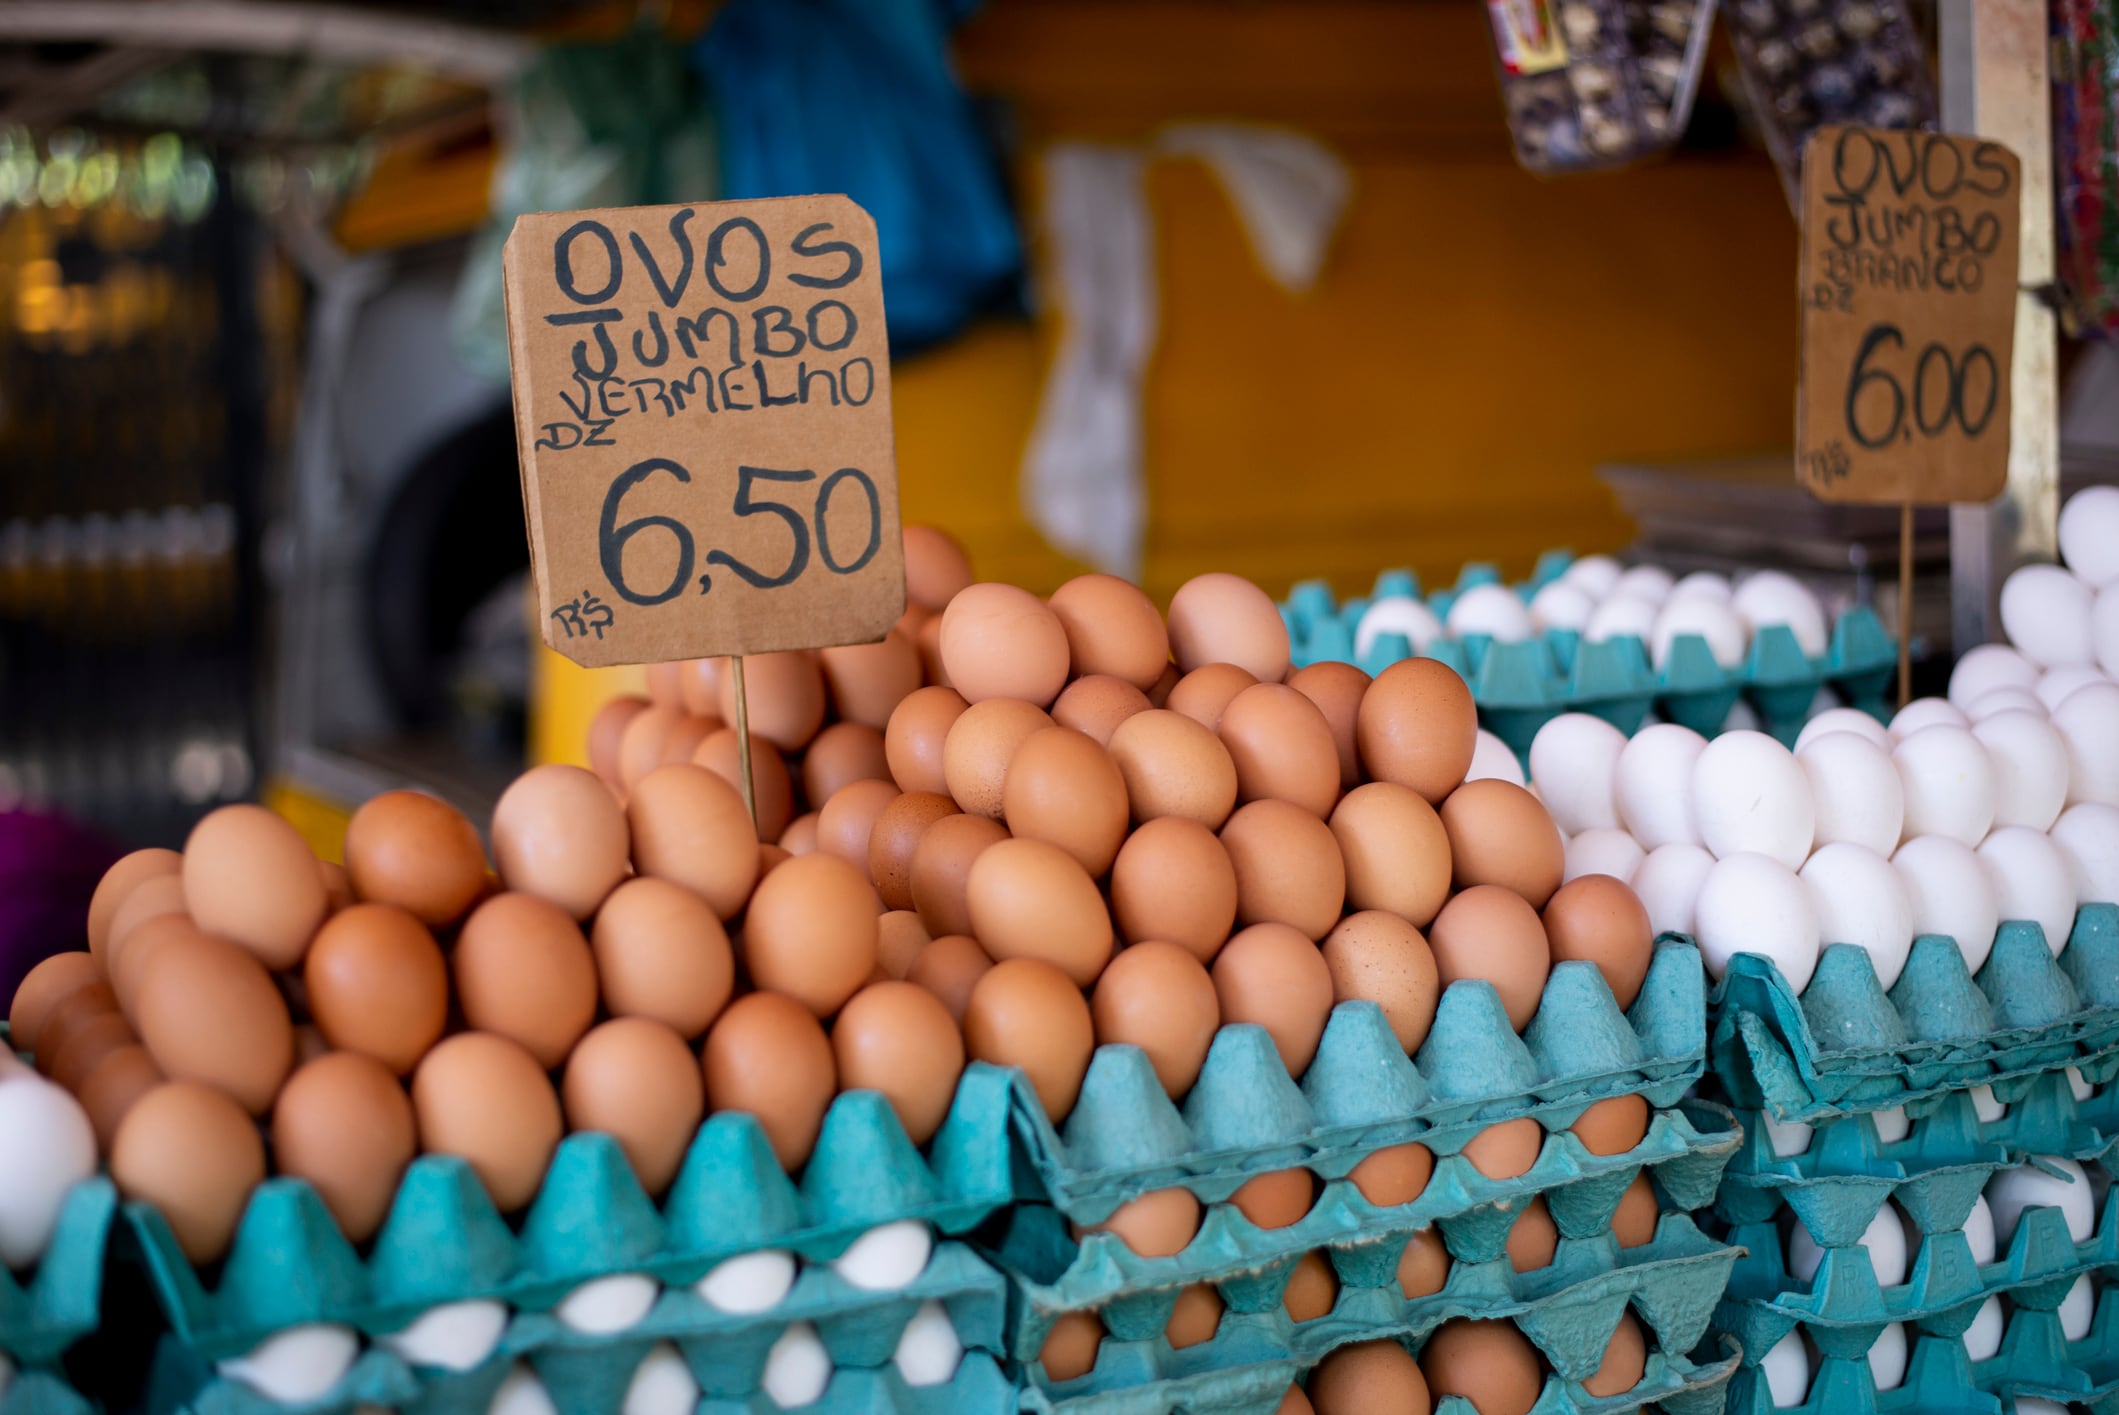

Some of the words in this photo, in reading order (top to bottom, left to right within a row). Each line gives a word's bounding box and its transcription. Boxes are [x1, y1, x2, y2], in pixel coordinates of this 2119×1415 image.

[1833, 126, 2010, 200] OVOS
[554, 208, 863, 308] OVOS
[1824, 194, 2001, 257] JUMBO
[1824, 252, 1984, 293] BRANCO
[543, 300, 858, 379] JUMBO
[534, 418, 616, 452] DZ
[599, 458, 881, 606] 6,50
